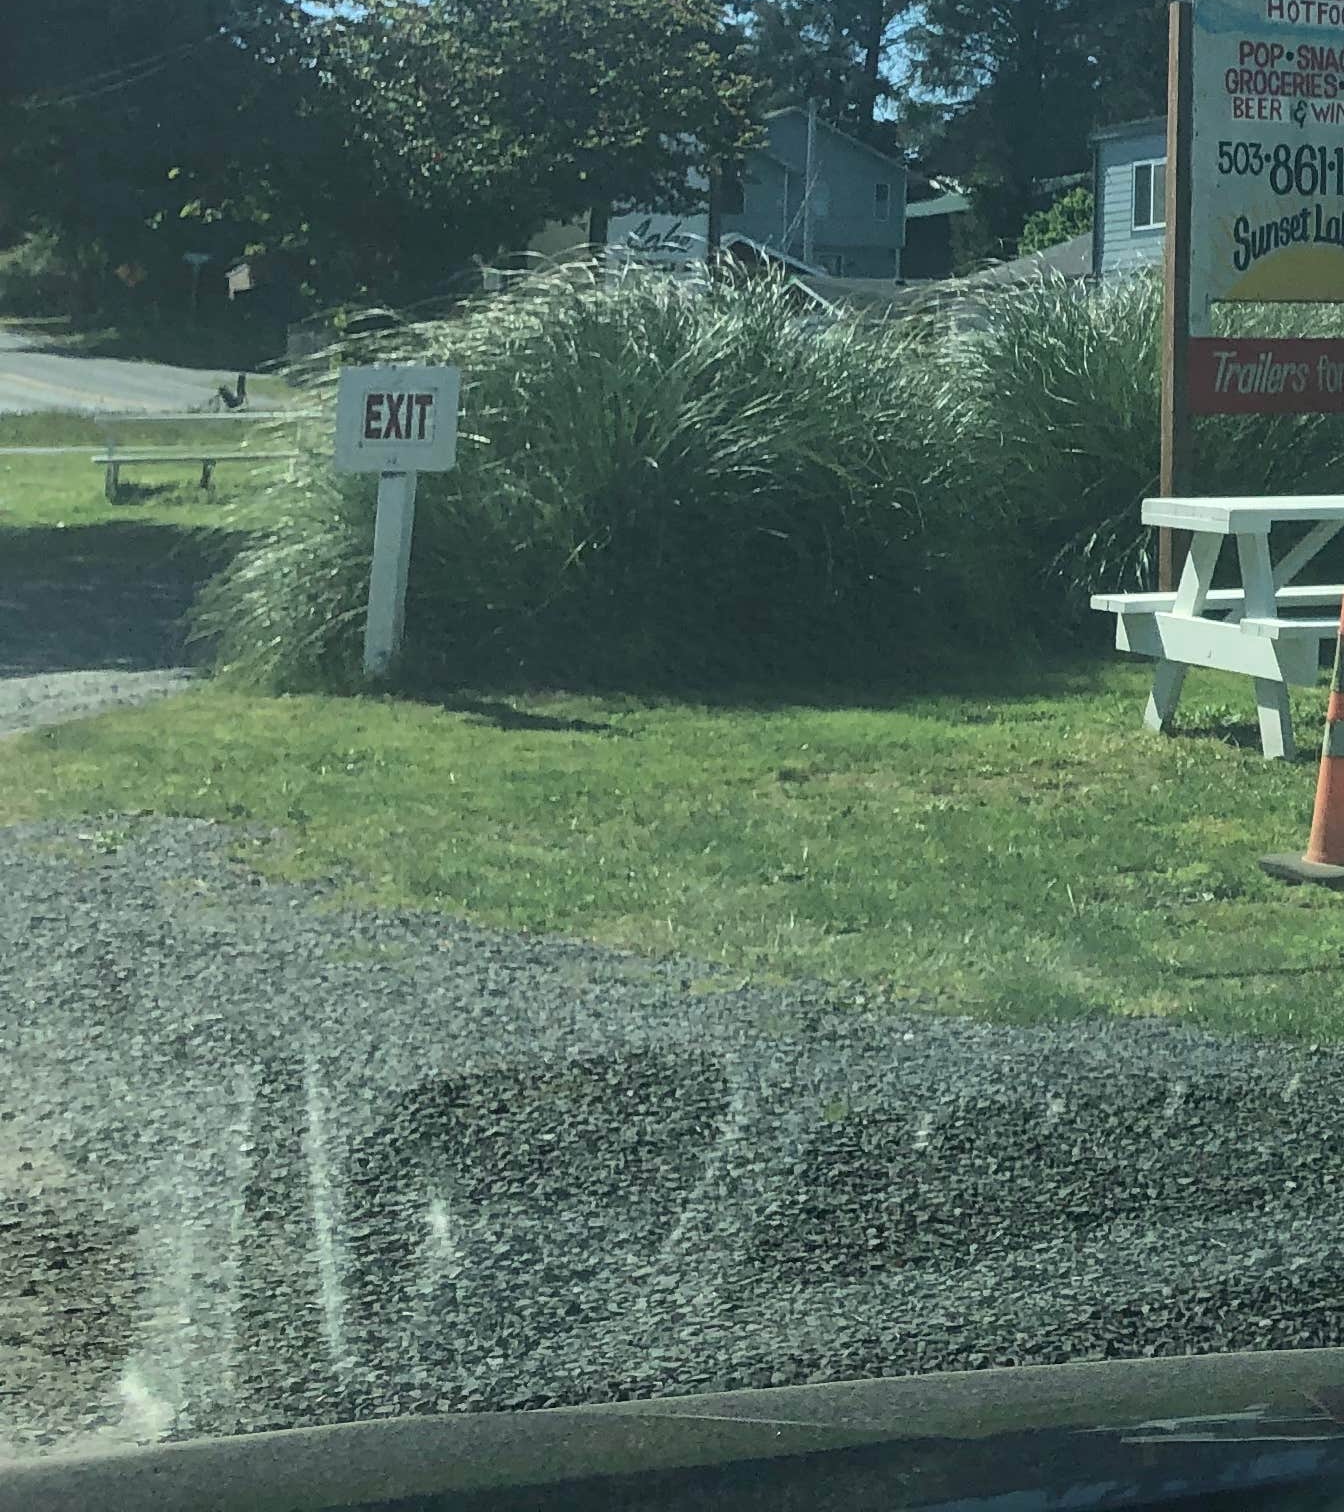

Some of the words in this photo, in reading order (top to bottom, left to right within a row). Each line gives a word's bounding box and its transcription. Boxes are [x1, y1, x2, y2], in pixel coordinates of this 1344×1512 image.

[1232, 96, 1283, 121] BEER
[1293, 100, 1308, 128] &
[1232, 207, 1312, 272] Sunset
[1212, 350, 1310, 393] Trailers
[364, 393, 434, 440] EXIT
